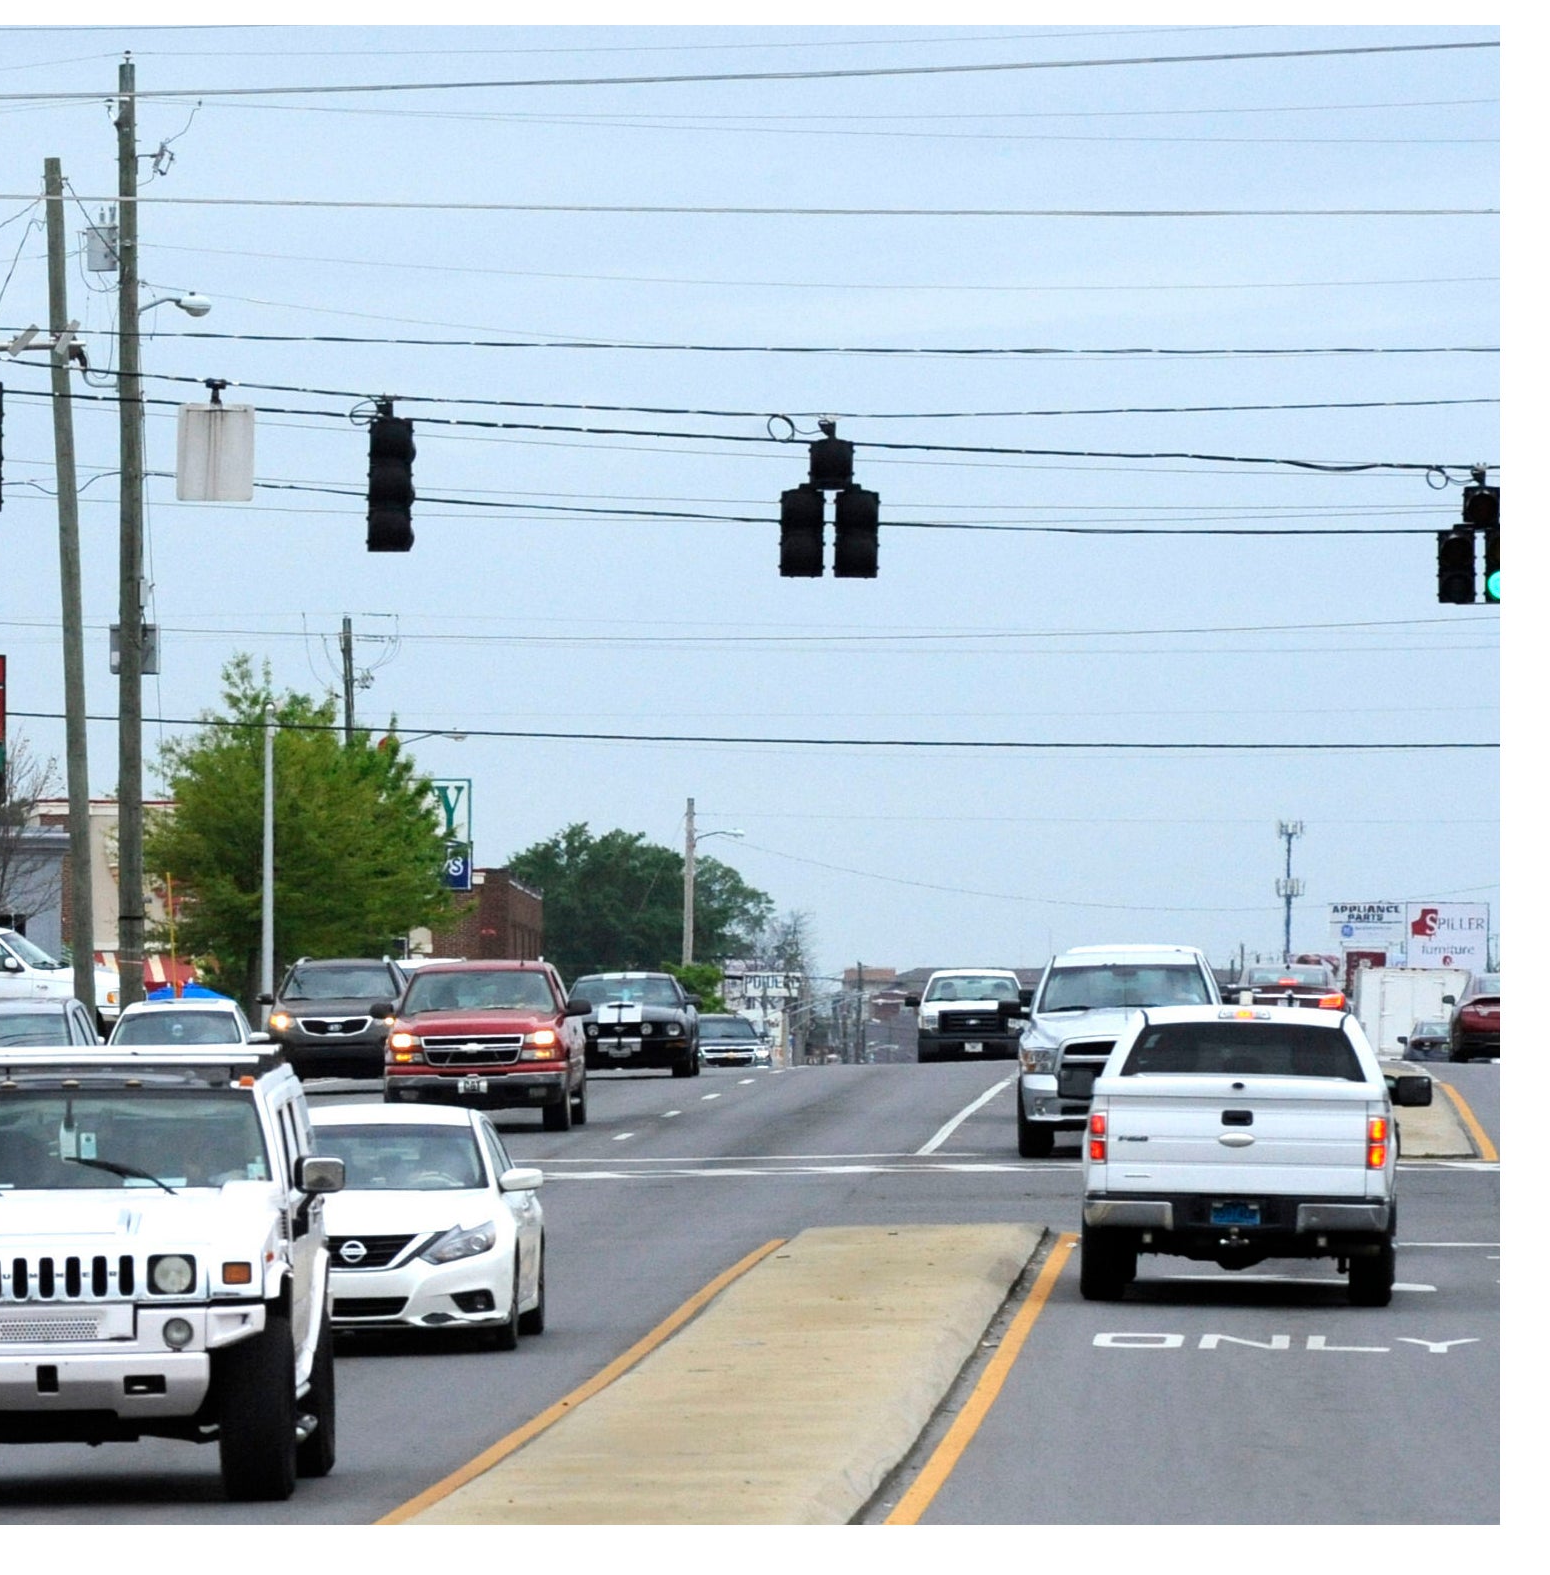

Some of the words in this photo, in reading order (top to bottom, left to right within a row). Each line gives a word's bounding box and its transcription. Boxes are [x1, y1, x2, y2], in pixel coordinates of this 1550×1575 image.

[1332, 904, 1401, 914] APPLIANCE
[1347, 914, 1384, 922] PARTS
[1426, 913, 1485, 935] SPILLER
[1092, 1333, 1481, 1353] ONLY
